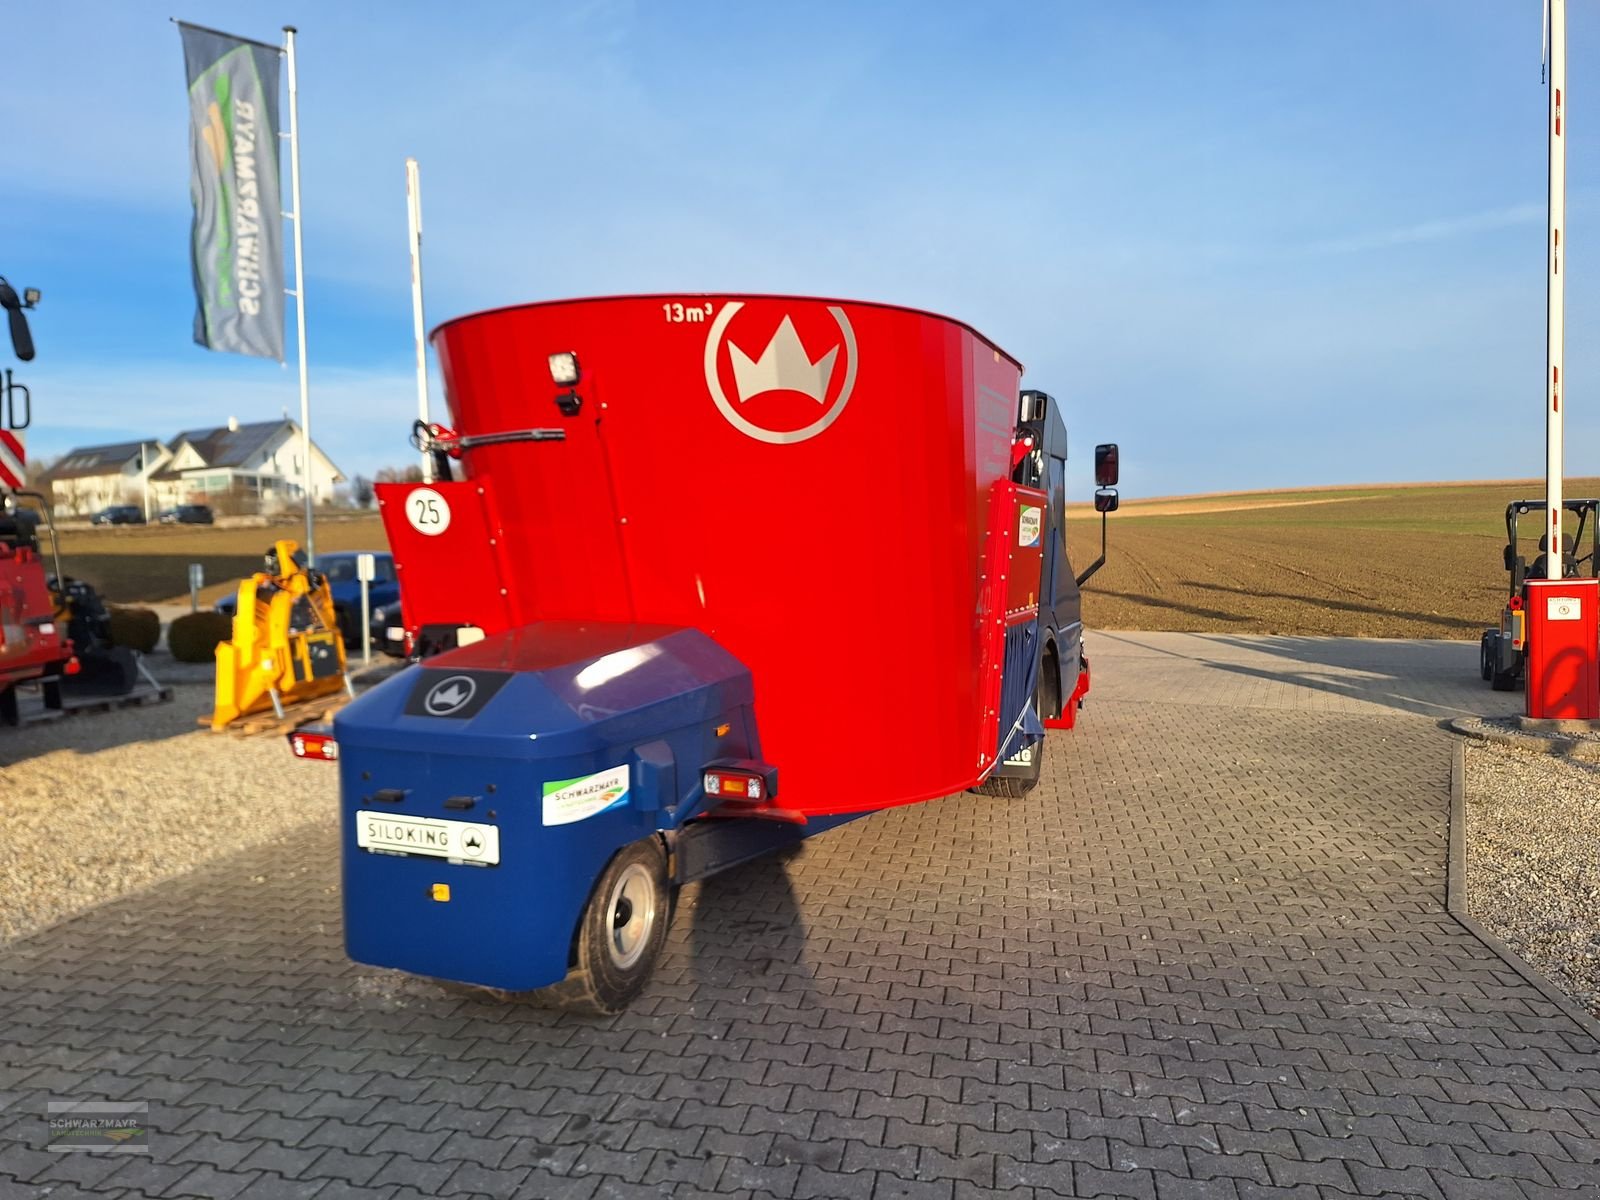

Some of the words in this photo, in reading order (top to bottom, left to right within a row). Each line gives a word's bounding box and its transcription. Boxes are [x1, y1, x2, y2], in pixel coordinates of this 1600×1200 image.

[415, 499, 440, 524] 25
[555, 778, 619, 801] SCHWARZMAYR
[368, 823, 448, 846] SILOKING
